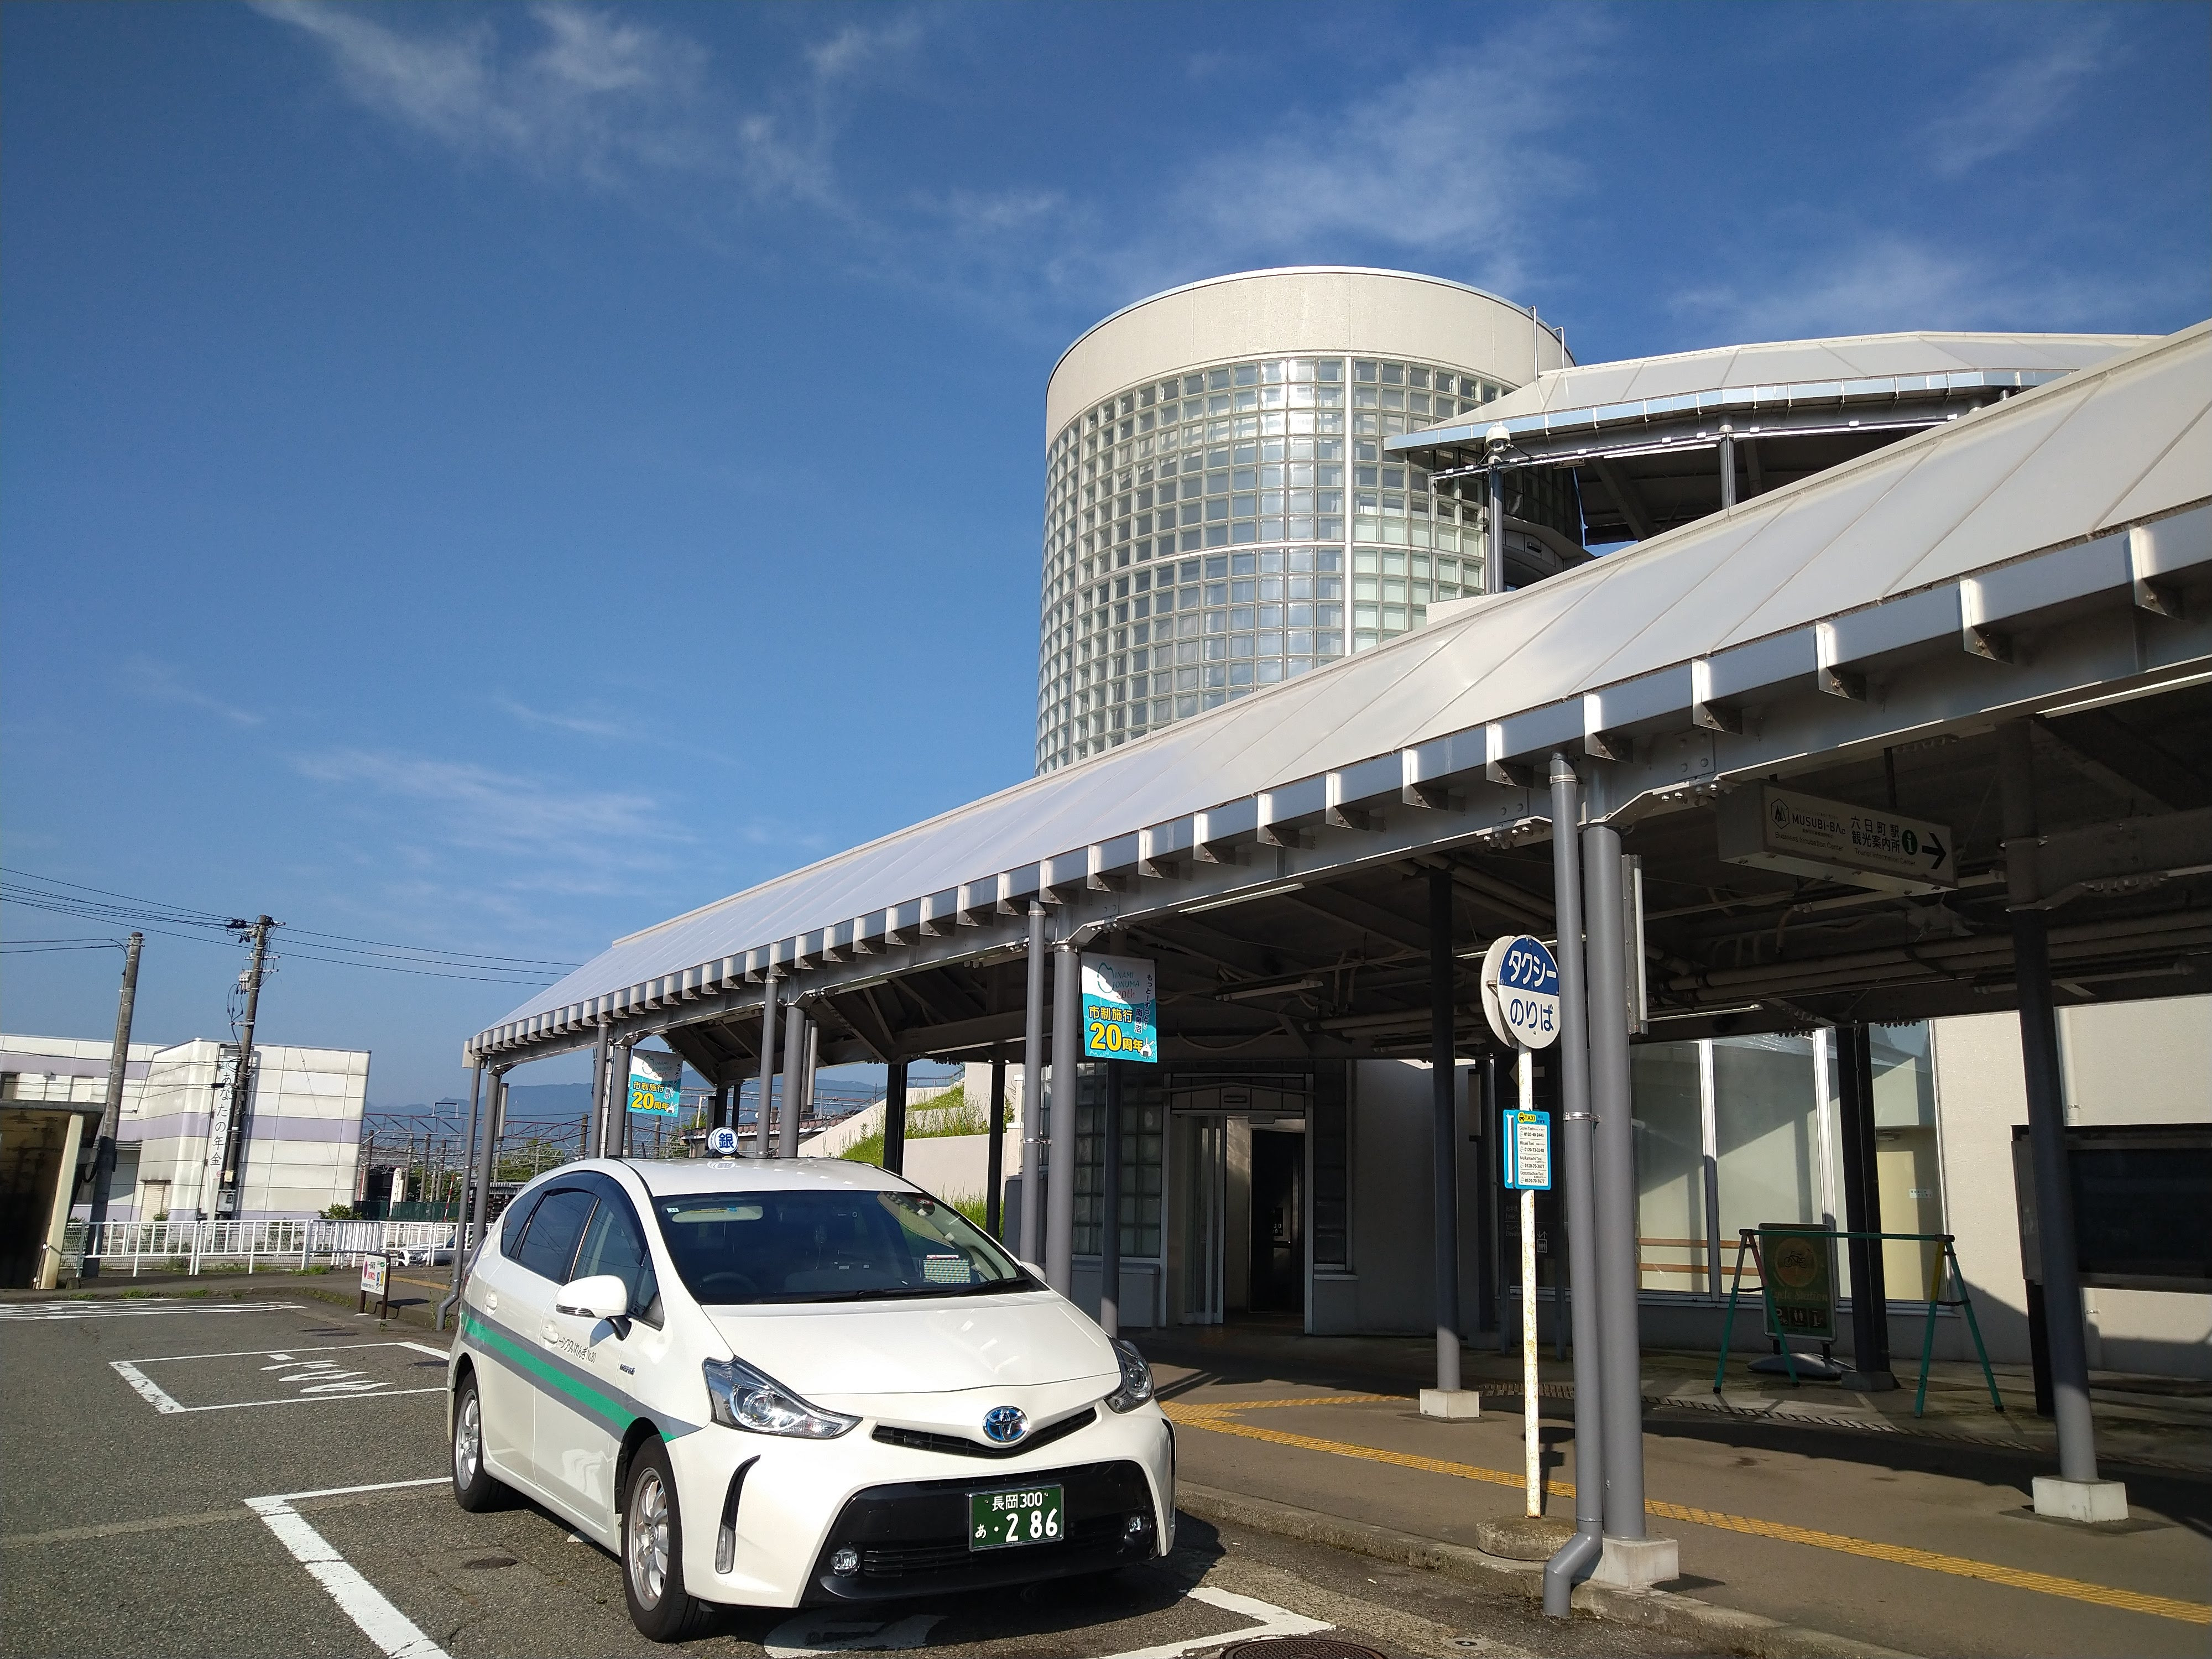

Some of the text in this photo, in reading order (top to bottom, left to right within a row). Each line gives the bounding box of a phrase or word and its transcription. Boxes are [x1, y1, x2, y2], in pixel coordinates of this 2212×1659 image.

[1851, 816, 1900, 838] 六日町駅
[1851, 830, 1900, 853] 観光案内所
[1509, 950, 1557, 987] タクシー
[1088, 1005, 1133, 1024] 市制施行
[1510, 998, 1554, 1032] のりば
[633, 1081, 665, 1093] 市制施行
[210, 1072, 233, 1166] あなたの年金
[718, 1133, 734, 1149] 銀
